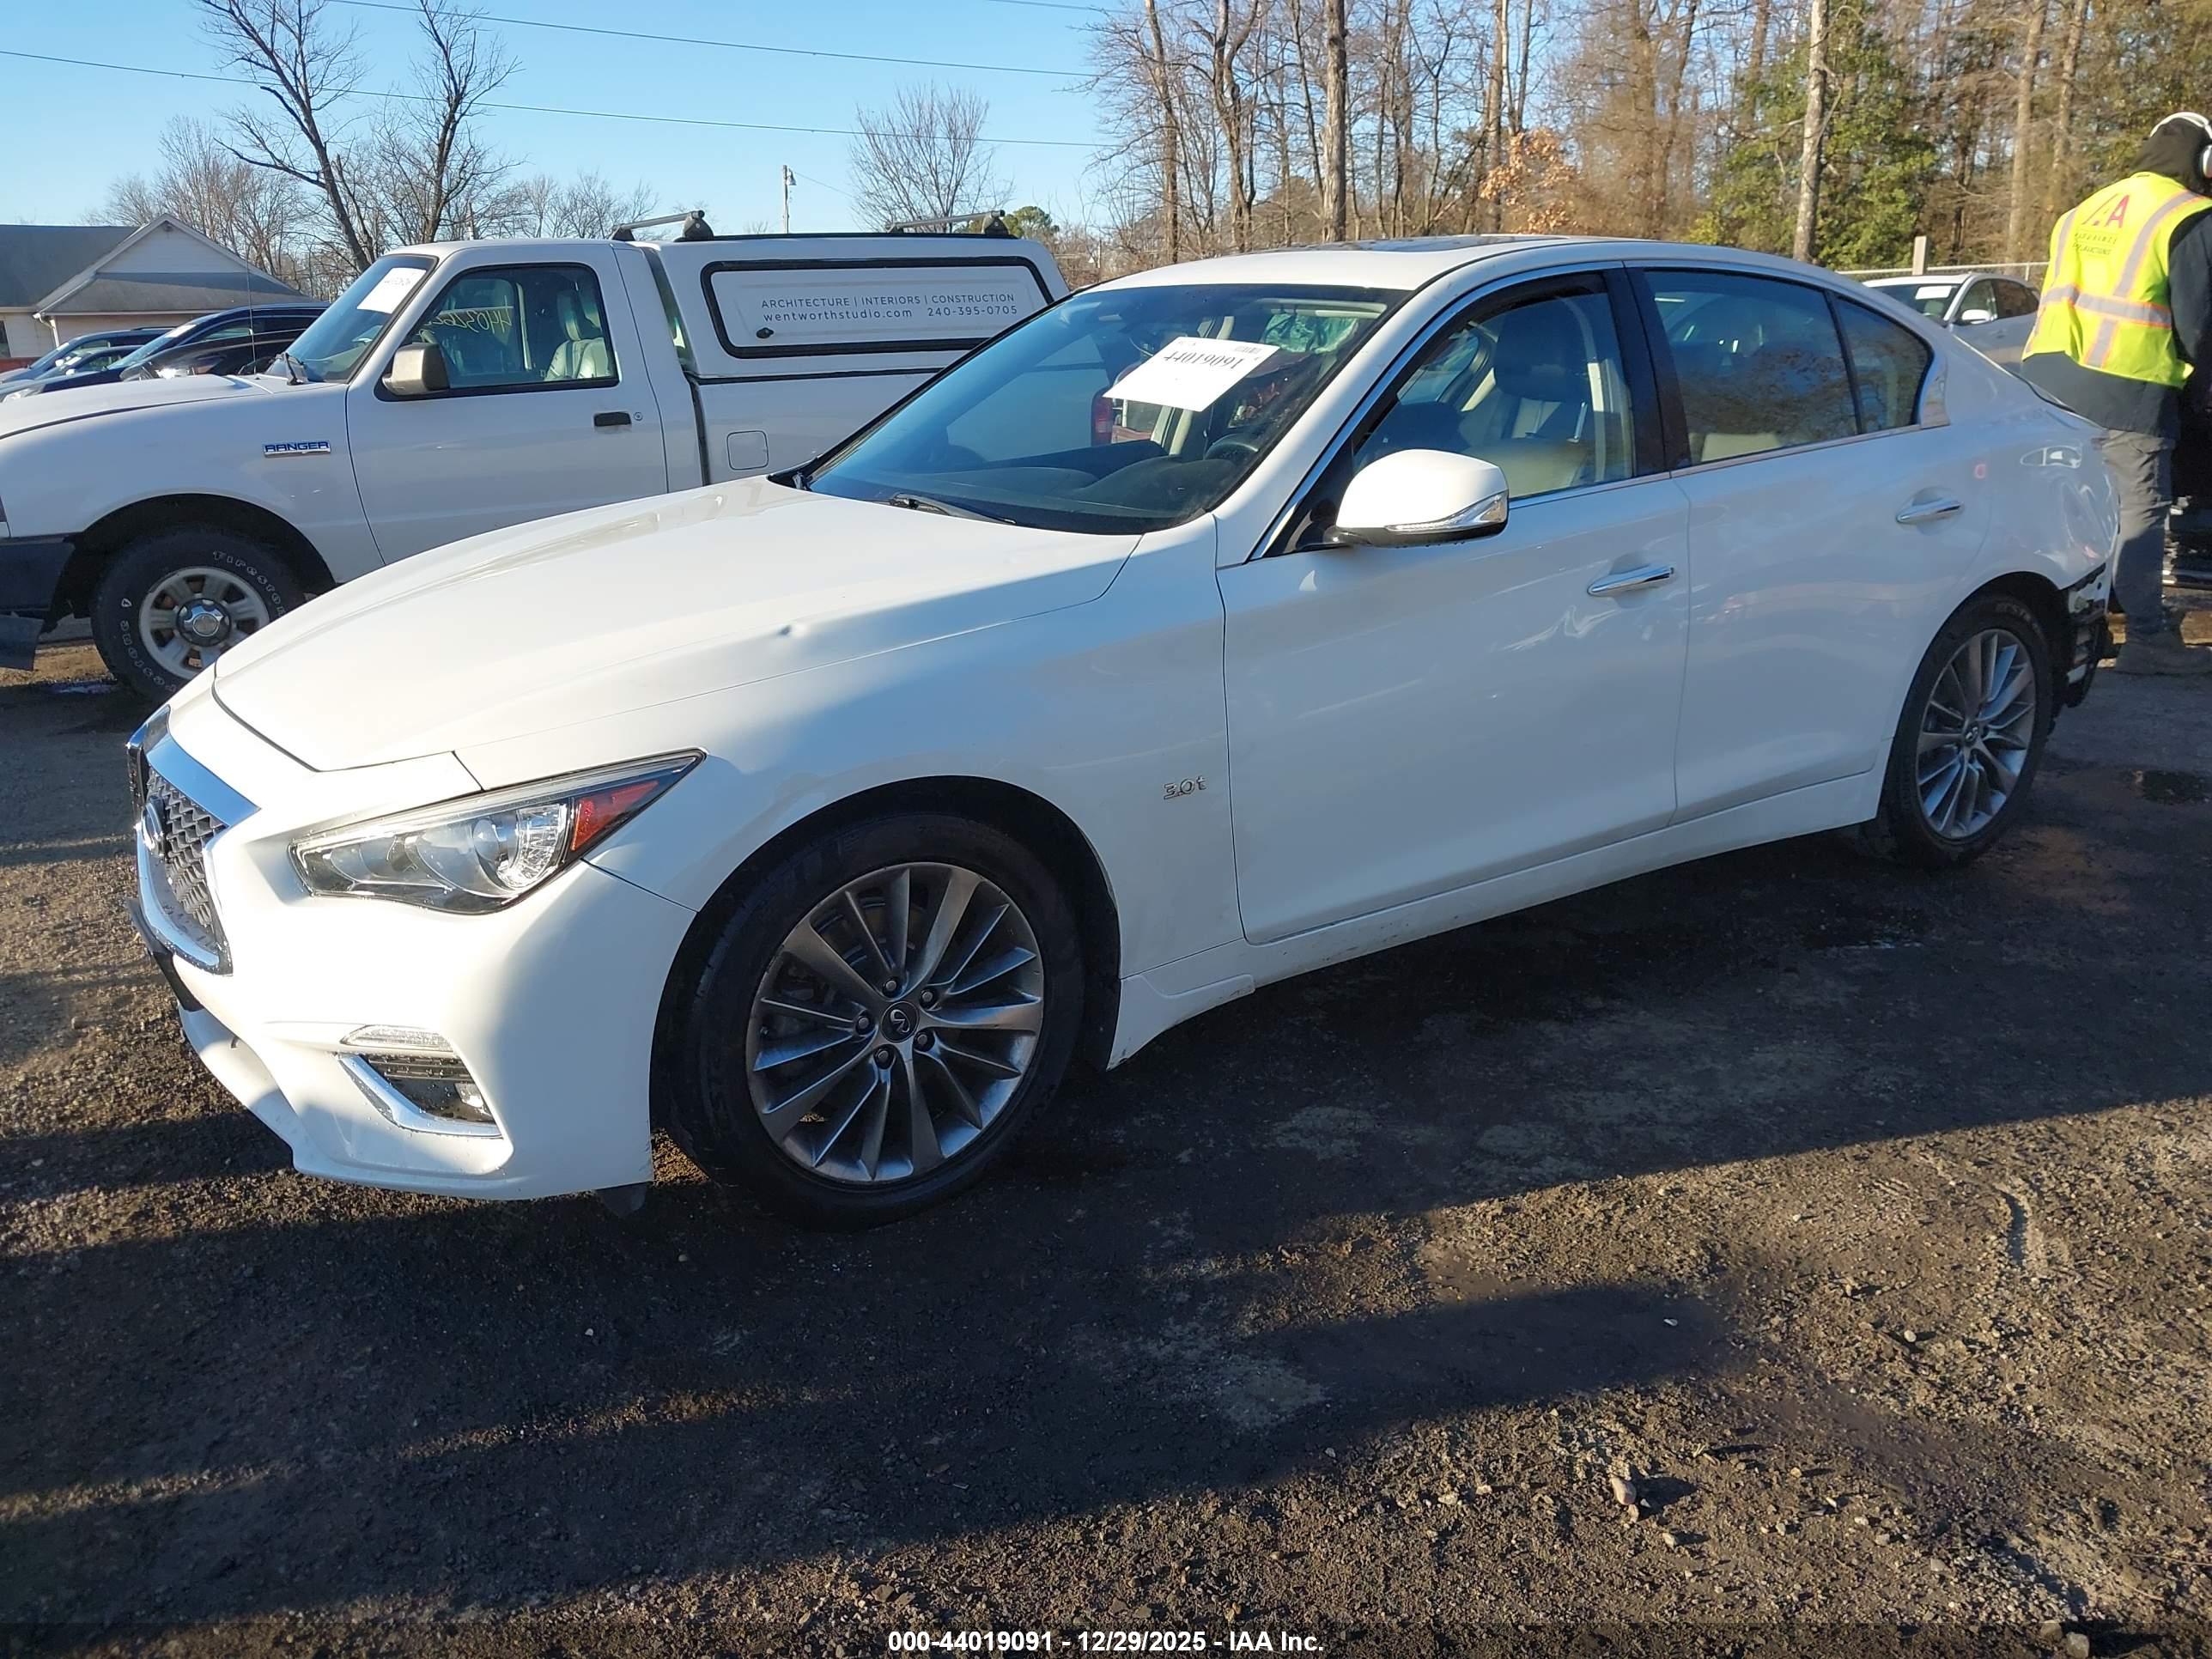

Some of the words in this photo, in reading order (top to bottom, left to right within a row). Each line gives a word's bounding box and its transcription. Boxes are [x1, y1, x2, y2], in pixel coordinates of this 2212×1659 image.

[761, 297, 850, 308] ARCHITECTURE
[861, 295, 921, 307] INTERIORS
[931, 294, 1015, 304] CONSTRUCTION
[763, 308, 914, 322] wentworthstudio.com
[927, 306, 1018, 317] 240-395-0705
[264, 441, 330, 453] RANGER
